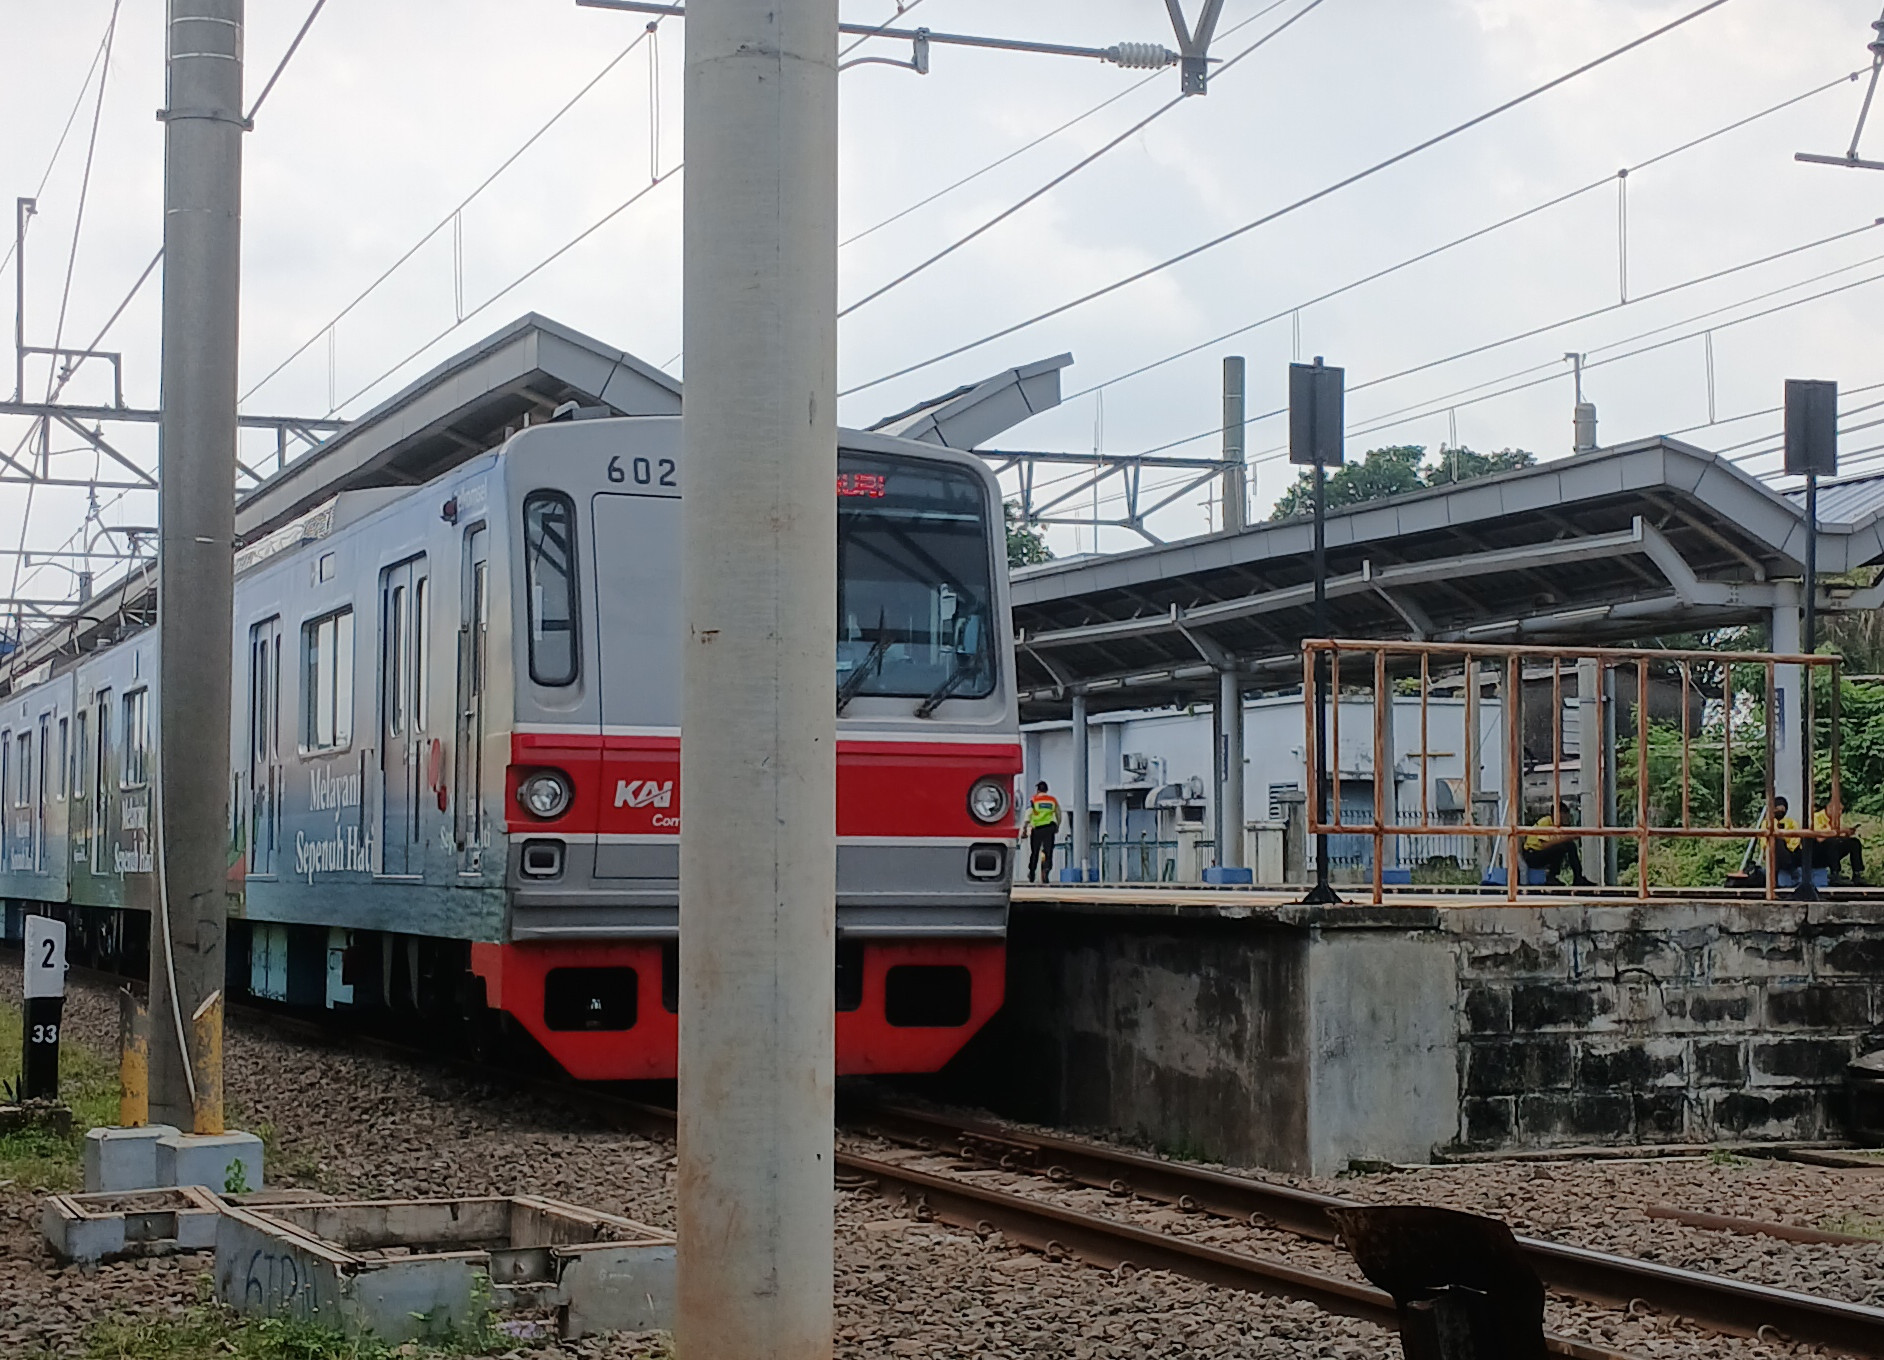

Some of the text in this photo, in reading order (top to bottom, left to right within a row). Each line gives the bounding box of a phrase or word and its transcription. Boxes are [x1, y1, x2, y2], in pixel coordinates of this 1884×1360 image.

[607, 455, 676, 487] 602
[309, 763, 362, 822] Melayani
[614, 780, 673, 808] KAI
[296, 823, 345, 885] Sepenuh
[42, 939, 55, 969] 2
[32, 1024, 58, 1044] 33
